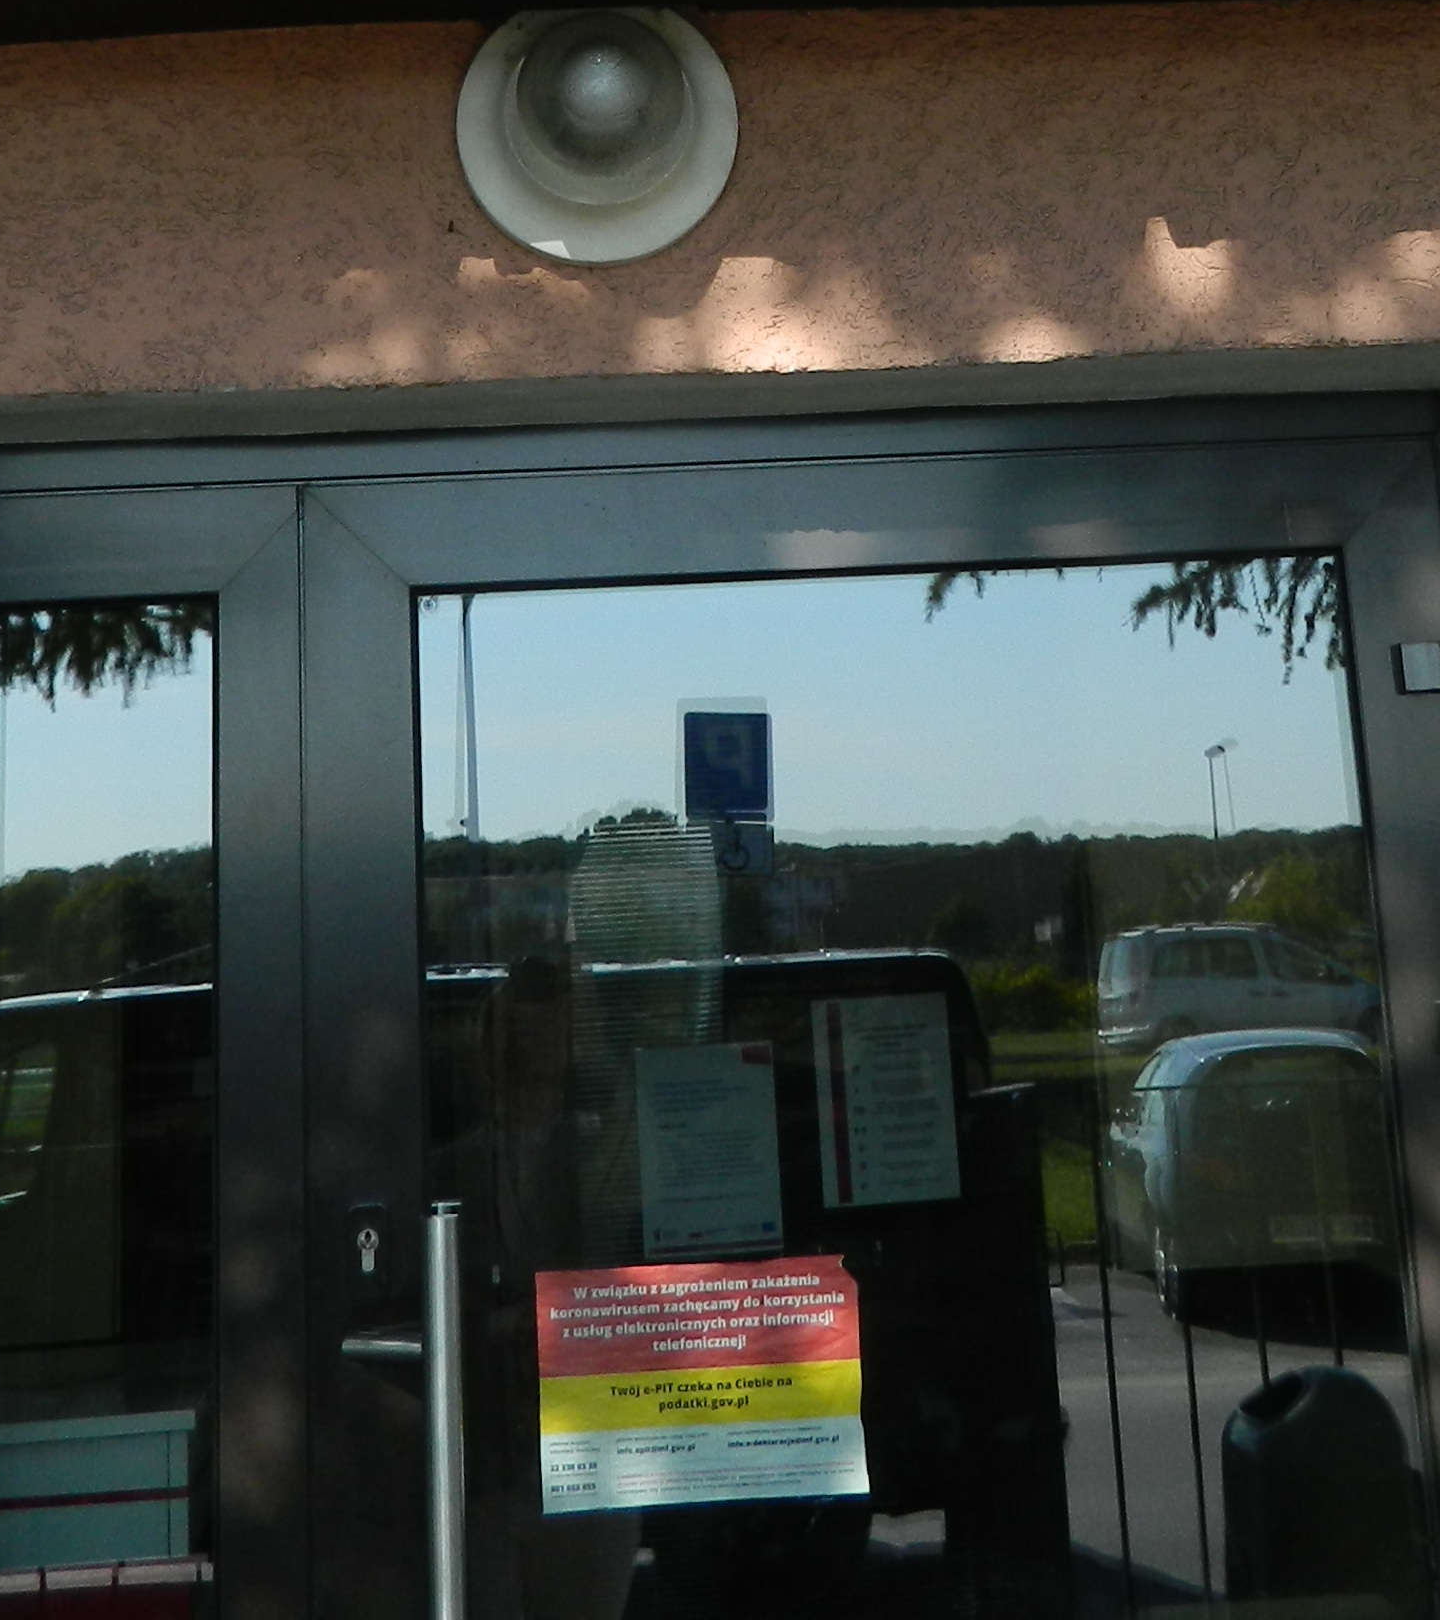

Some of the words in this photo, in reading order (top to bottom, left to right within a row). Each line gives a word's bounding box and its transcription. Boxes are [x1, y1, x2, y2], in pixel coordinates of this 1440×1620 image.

[574, 1287, 587, 1299] W
[592, 1286, 647, 1299] związku
[651, 1285, 657, 1294] z
[661, 1278, 748, 1298] zagrożeniem
[752, 1273, 820, 1288] zakażenia
[550, 1303, 659, 1320] koronawirusem
[664, 1296, 739, 1314] zachęcamy
[743, 1296, 759, 1307] do
[764, 1291, 844, 1309] korzystania
[563, 1327, 569, 1338] z
[574, 1324, 611, 1339] usług
[616, 1317, 725, 1334] elektronicznych
[730, 1316, 759, 1326] oraz
[763, 1310, 833, 1326] informacji
[653, 1335, 746, 1351] telefonicznej!
[610, 1384, 640, 1397] Twój
[644, 1383, 673, 1395] e-PIT
[678, 1381, 712, 1391] czeka
[717, 1381, 731, 1389] na
[736, 1377, 772, 1389] Ciebie
[777, 1377, 792, 1387] na
[659, 1396, 749, 1413] podatki.gov.pl
